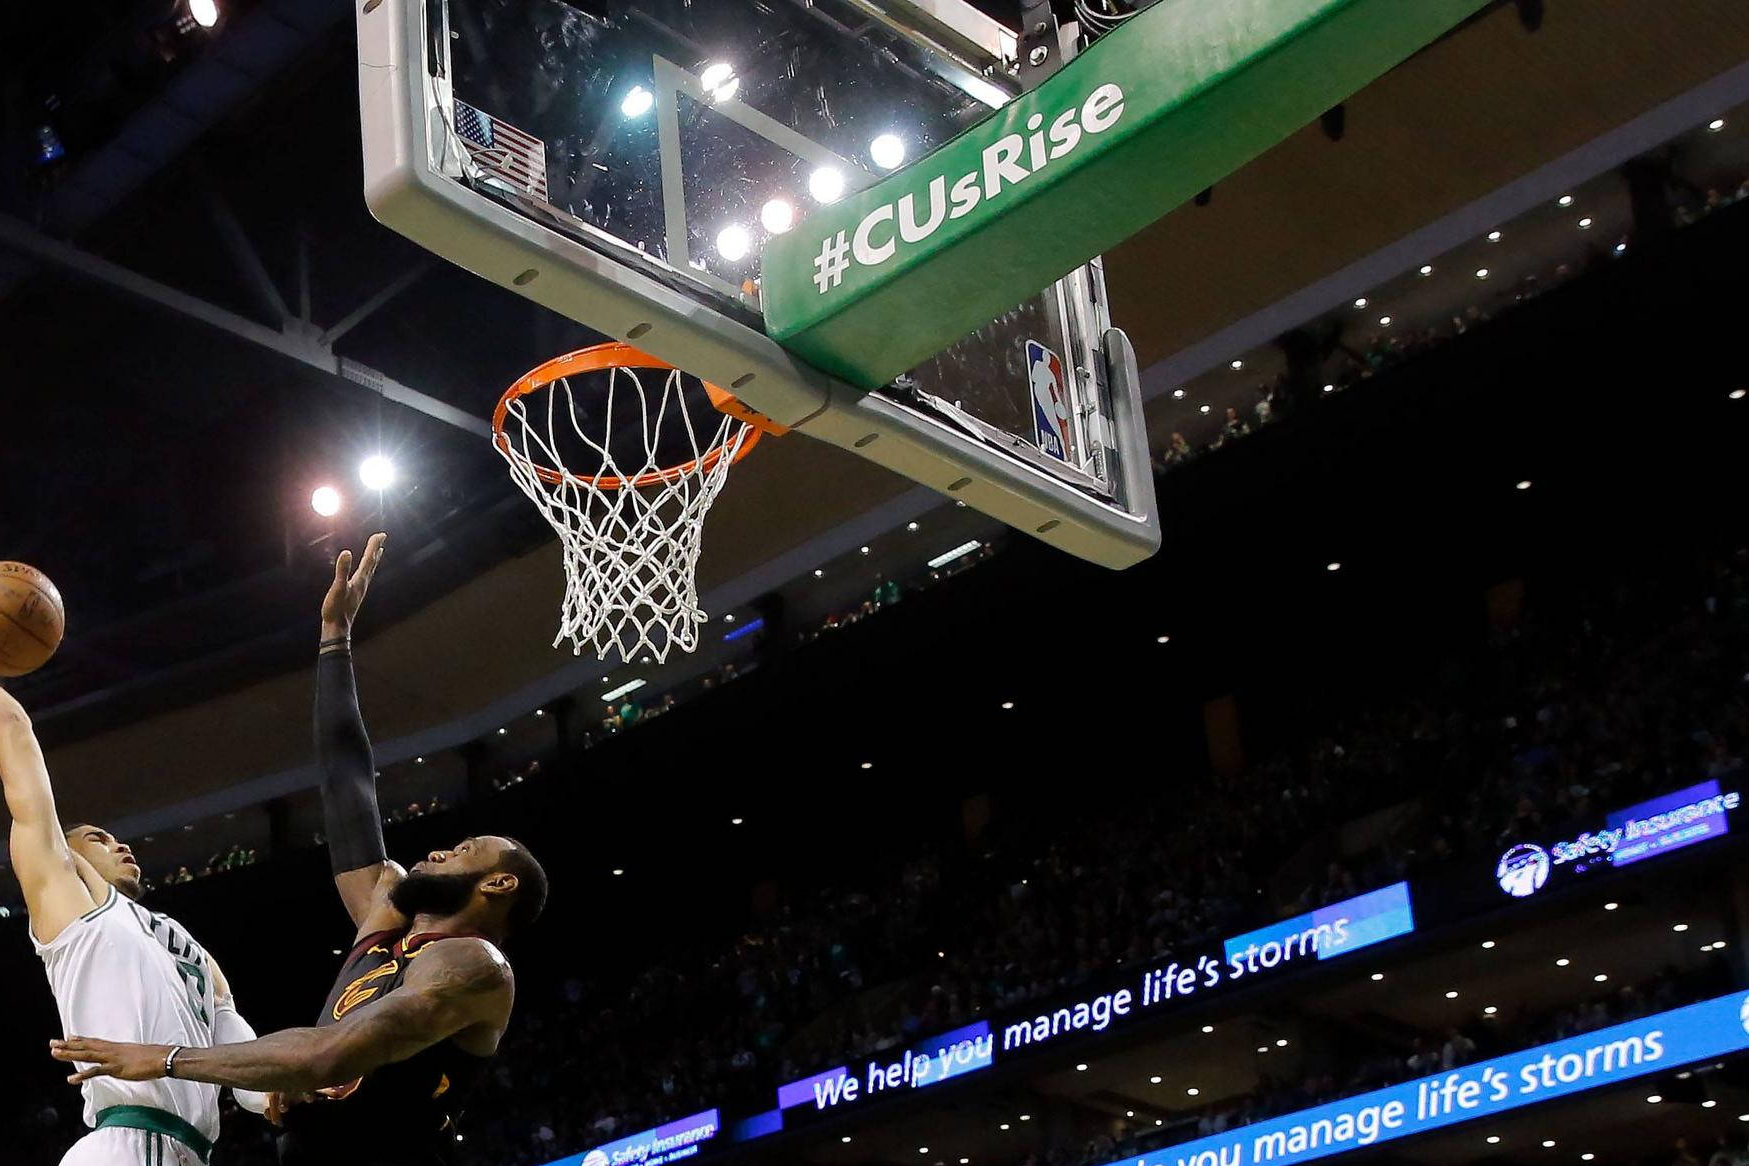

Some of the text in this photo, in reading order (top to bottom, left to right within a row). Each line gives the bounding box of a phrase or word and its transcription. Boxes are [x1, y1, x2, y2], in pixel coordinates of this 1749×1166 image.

[812, 81, 1126, 296] #CUsRise
[814, 917, 1350, 1110] We help you manage life's storms
[611, 1123, 715, 1166] Safety Insurance
[1252, 1100, 1404, 1163] manage
[1417, 1067, 1510, 1120] life's
[1520, 1029, 1664, 1094] storms
